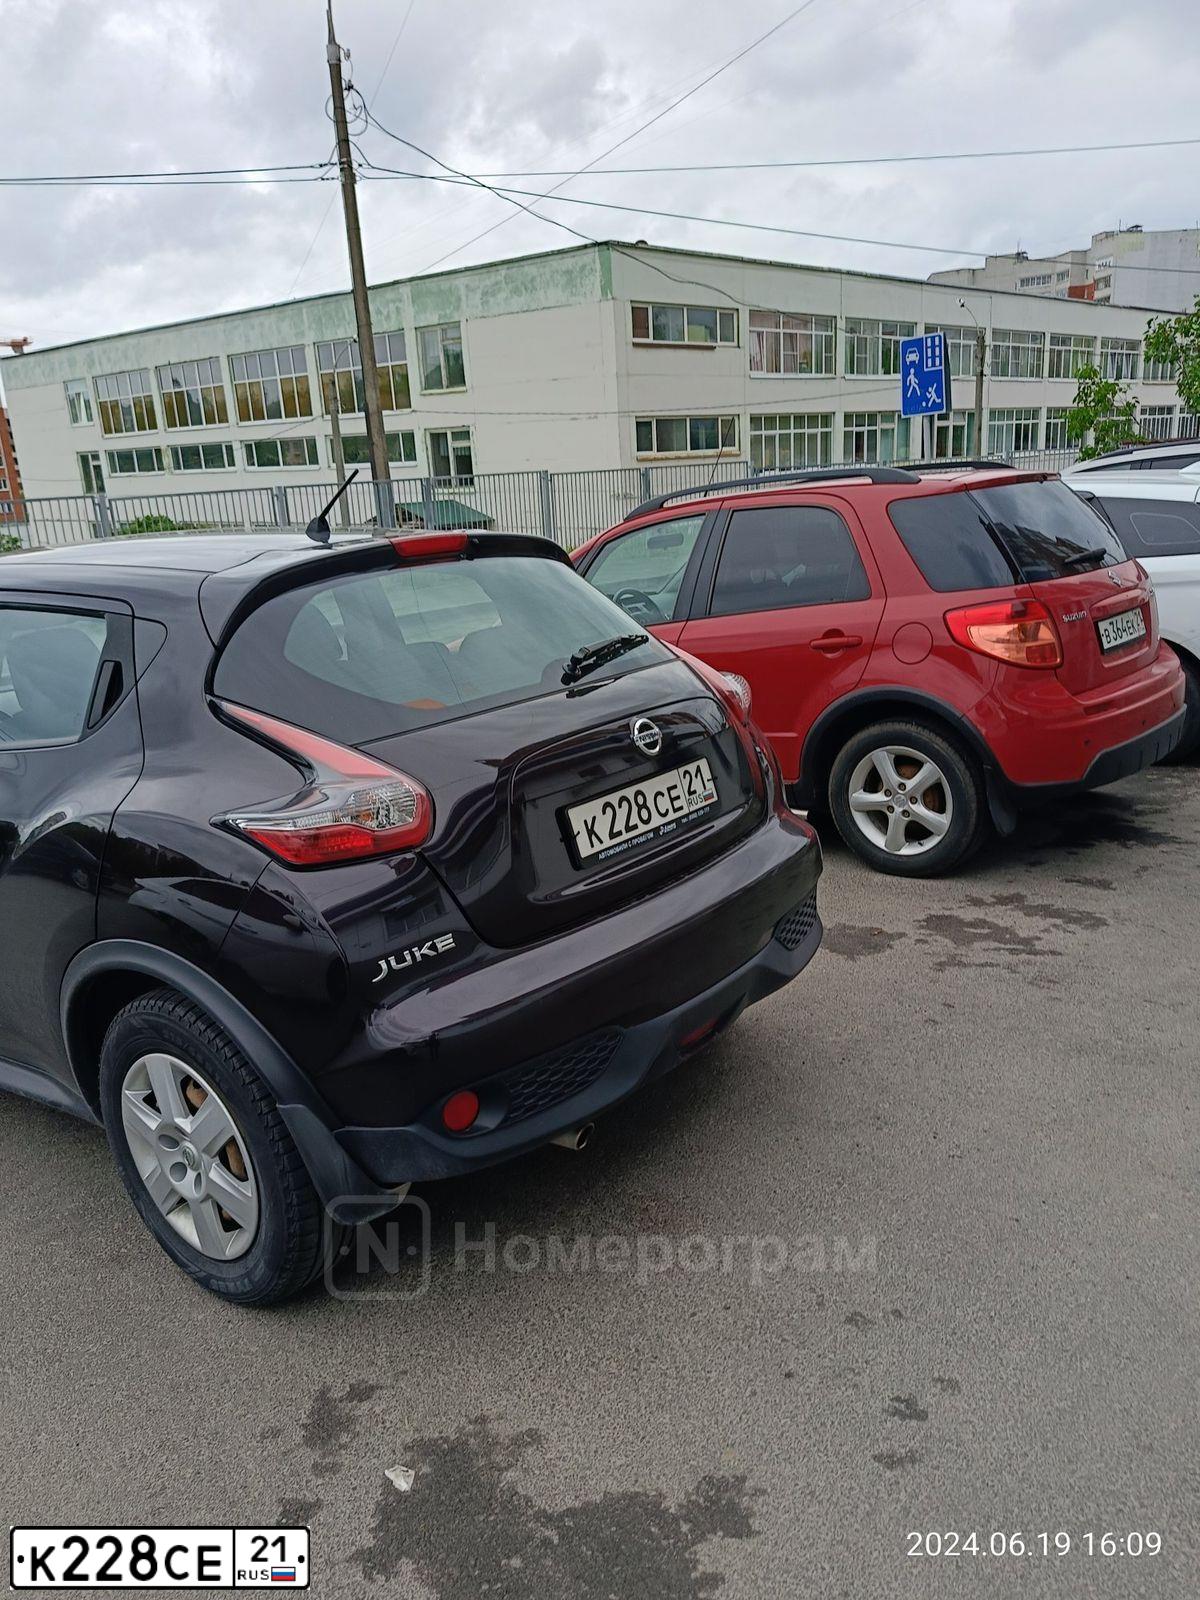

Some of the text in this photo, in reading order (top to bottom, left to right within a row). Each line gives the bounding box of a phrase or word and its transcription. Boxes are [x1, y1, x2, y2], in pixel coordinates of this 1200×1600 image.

[583, 764, 707, 848] К228СЕ 21
[687, 796, 704, 808] RUS
[372, 933, 457, 982] JUKE
